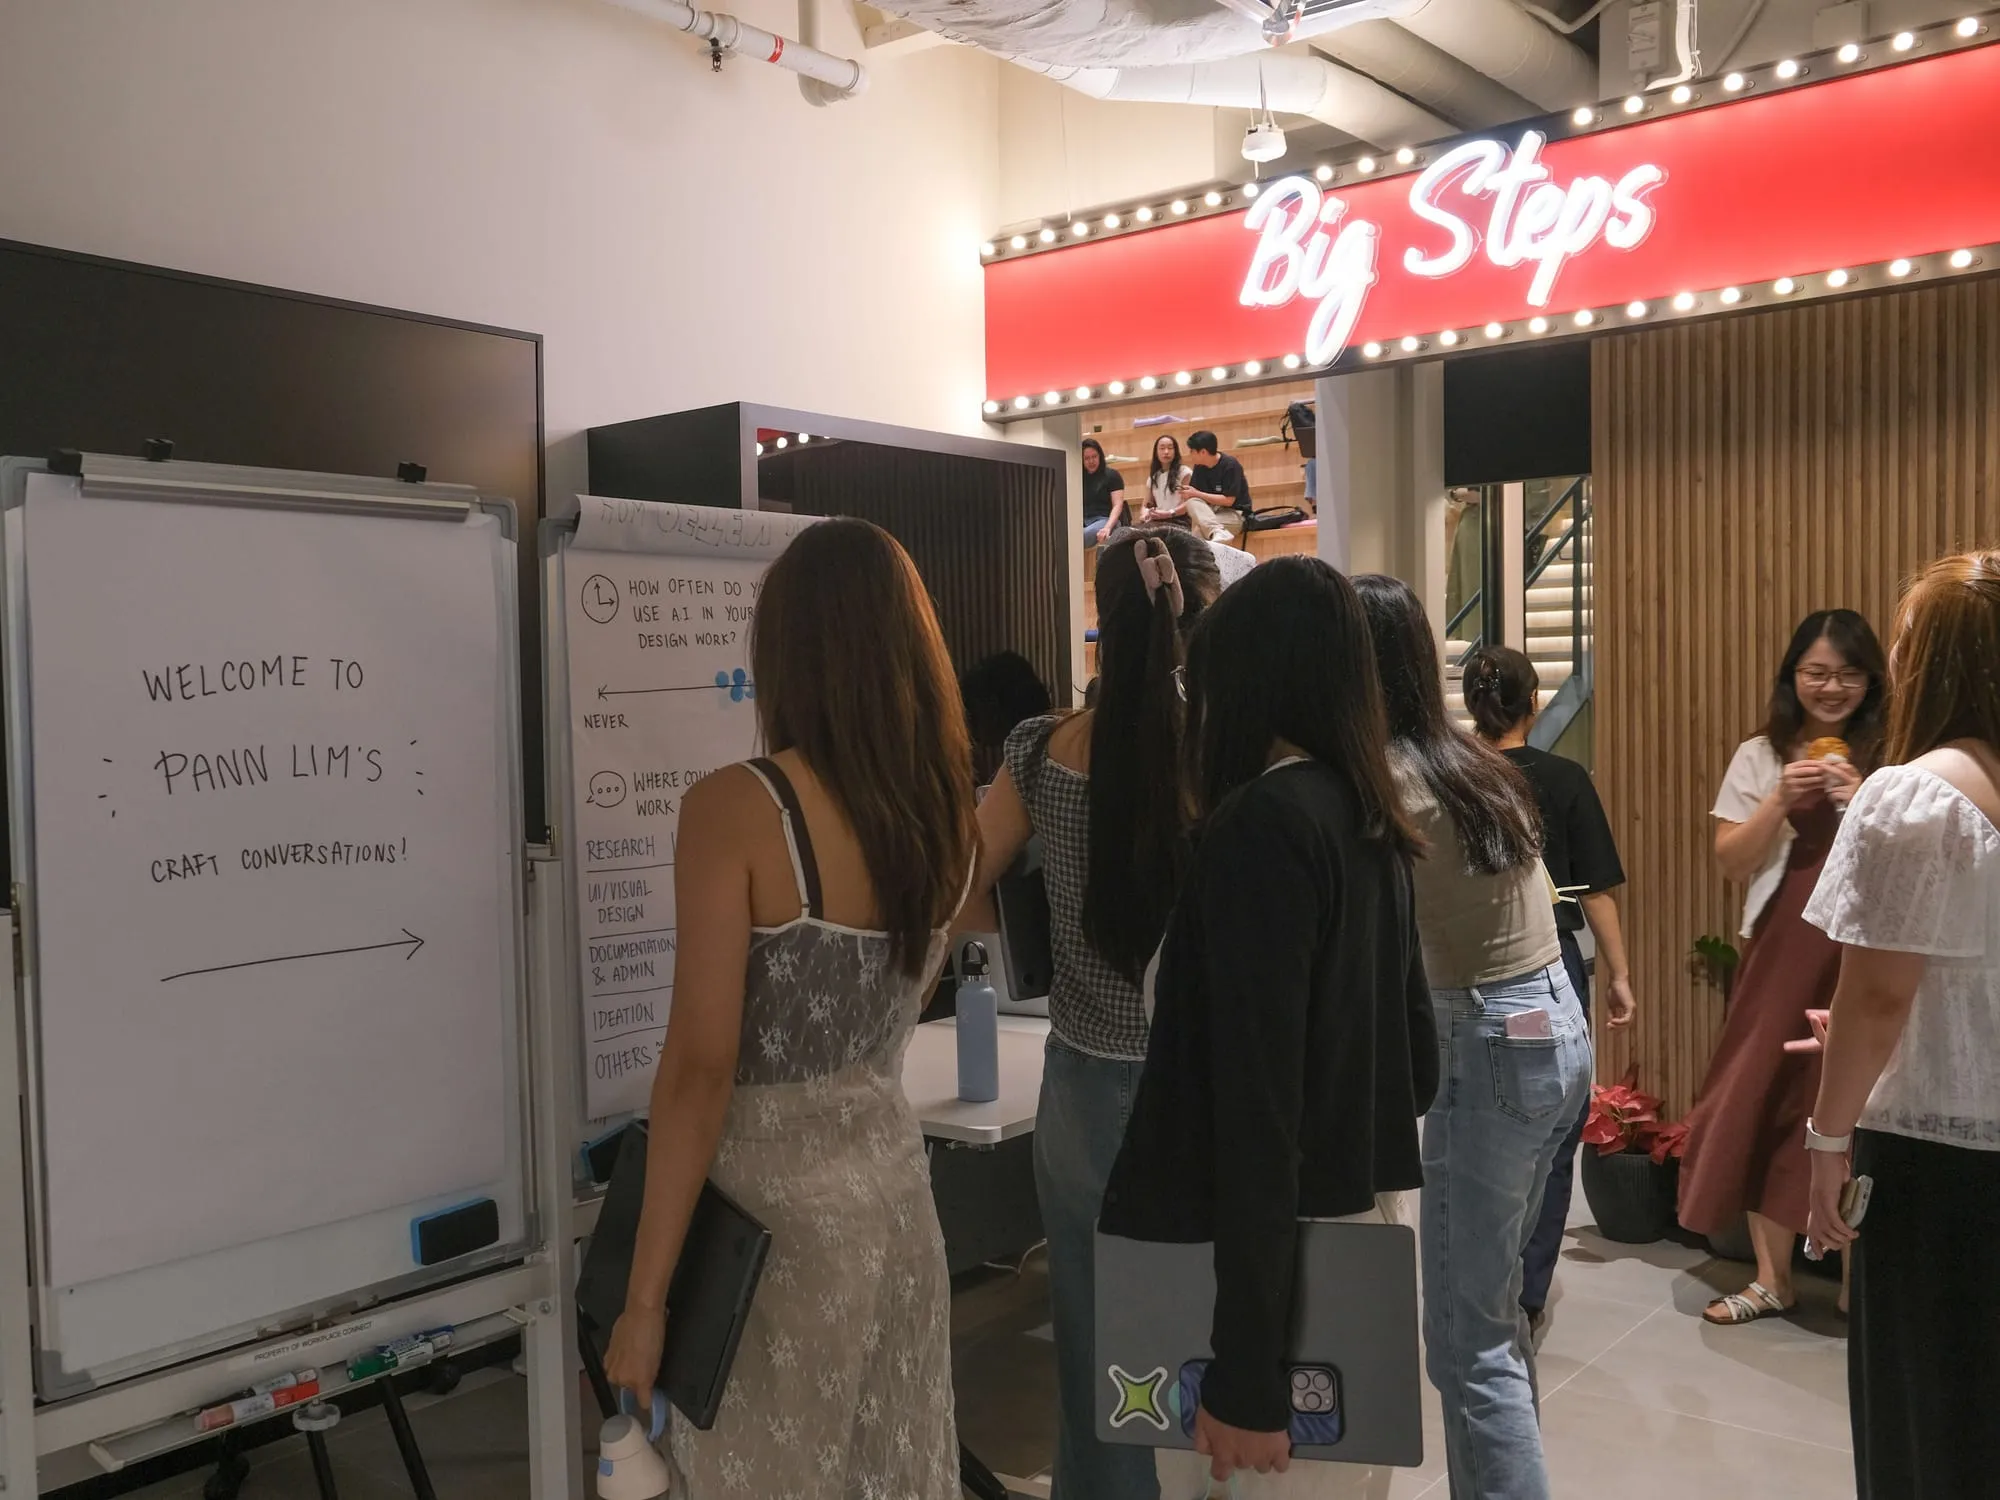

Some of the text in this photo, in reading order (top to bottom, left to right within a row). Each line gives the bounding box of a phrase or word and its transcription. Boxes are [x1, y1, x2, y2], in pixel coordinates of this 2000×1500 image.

[1239, 130, 1667, 368] Big Steps
[629, 580, 659, 597] HOW
[668, 578, 714, 595] OFTEN
[724, 581, 741, 596] DO
[633, 605, 660, 623] USE
[702, 606, 714, 620] IN
[725, 605, 754, 622] YOUR
[638, 631, 736, 648] DESIGN WORK?
[142, 656, 364, 702] WELCOME TO
[584, 713, 629, 729] NEVER
[154, 745, 383, 794] PANN LIM'S
[633, 771, 680, 792] WHERE
[636, 799, 675, 817] WORK
[150, 837, 407, 884] CRAFT CONVERSATIONS!
[586, 834, 655, 862] RESEARCH
[588, 880, 653, 903] UI/VISUAL
[598, 904, 644, 924] DESIGN
[589, 937, 676, 964] DOCUMENTATION
[592, 960, 655, 986] & ADMIN
[593, 1002, 654, 1032] IDEATION
[595, 1046, 653, 1079] OTHERS
[254, 1321, 372, 1360] PROPERTY OF WORKPLACE CONNECT
